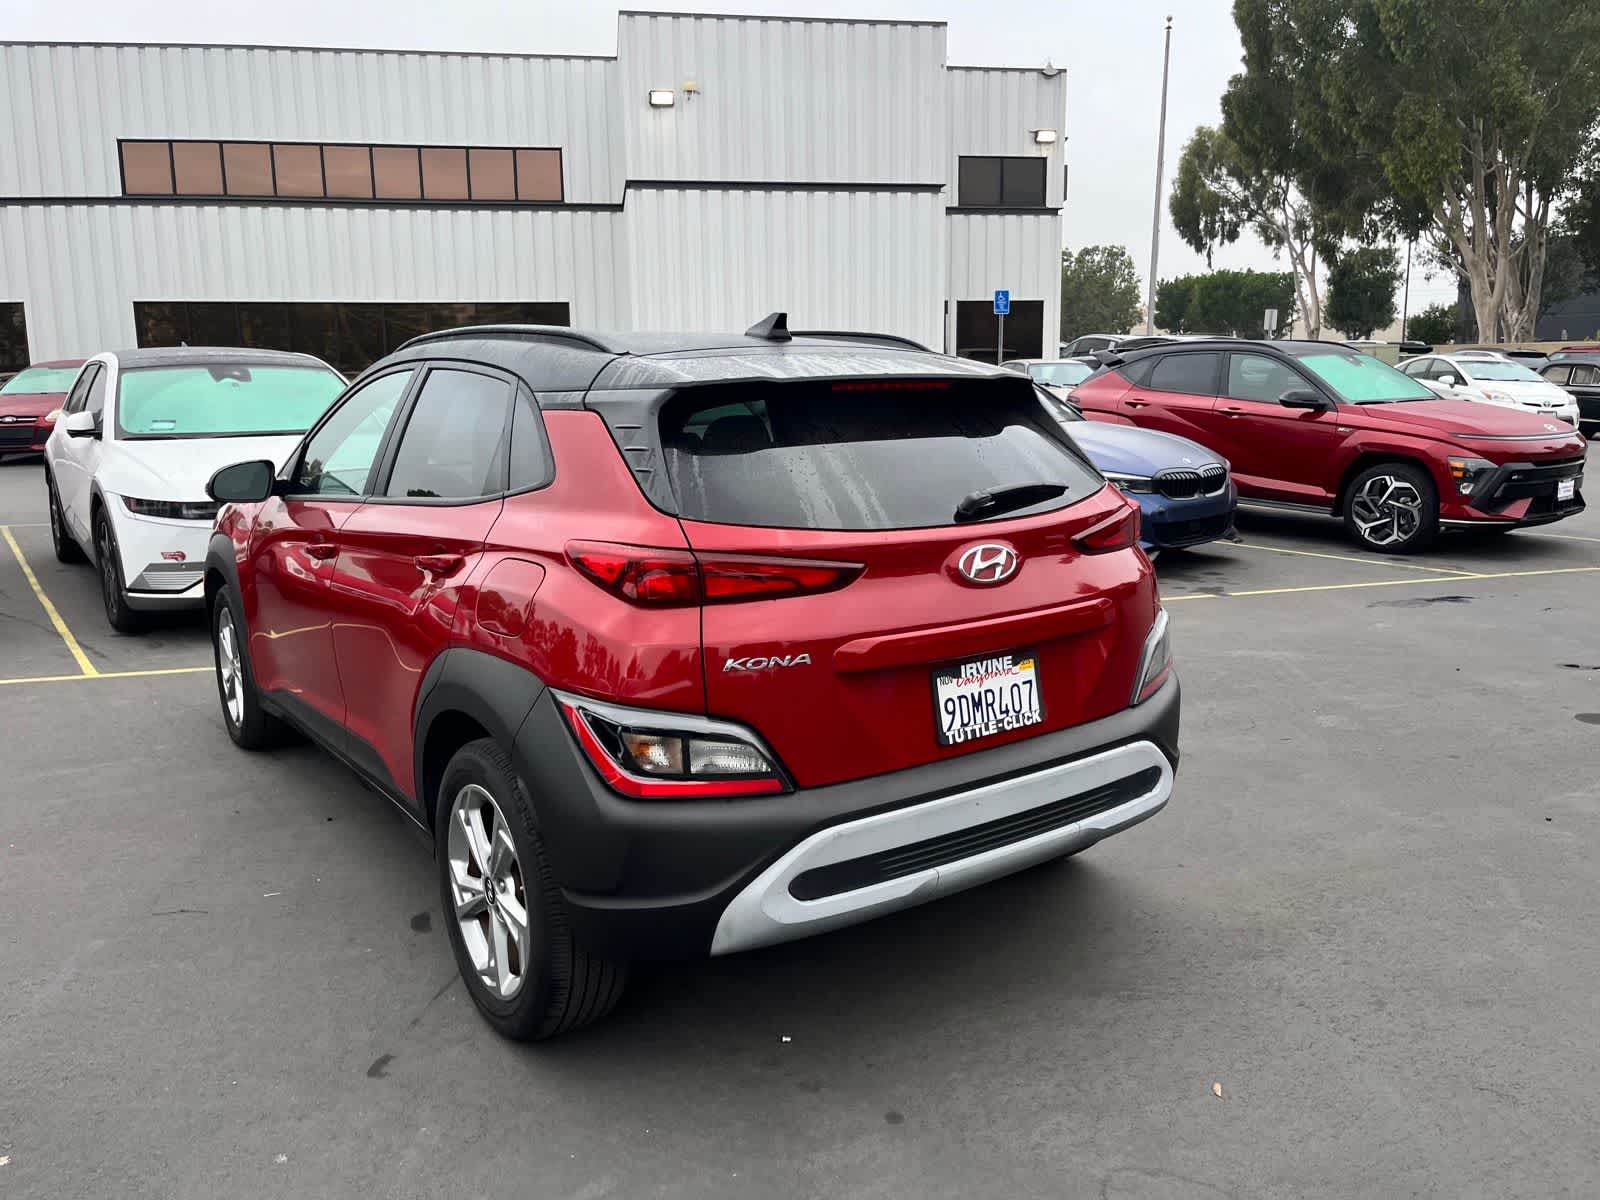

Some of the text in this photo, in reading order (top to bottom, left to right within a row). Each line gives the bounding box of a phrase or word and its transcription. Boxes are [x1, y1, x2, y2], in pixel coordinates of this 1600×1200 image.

[723, 653, 811, 672] KONA
[960, 656, 1012, 679] IRVINE
[944, 679, 1033, 732] 9DMR407
[945, 710, 1042, 745] TUTTLE-CLICK
